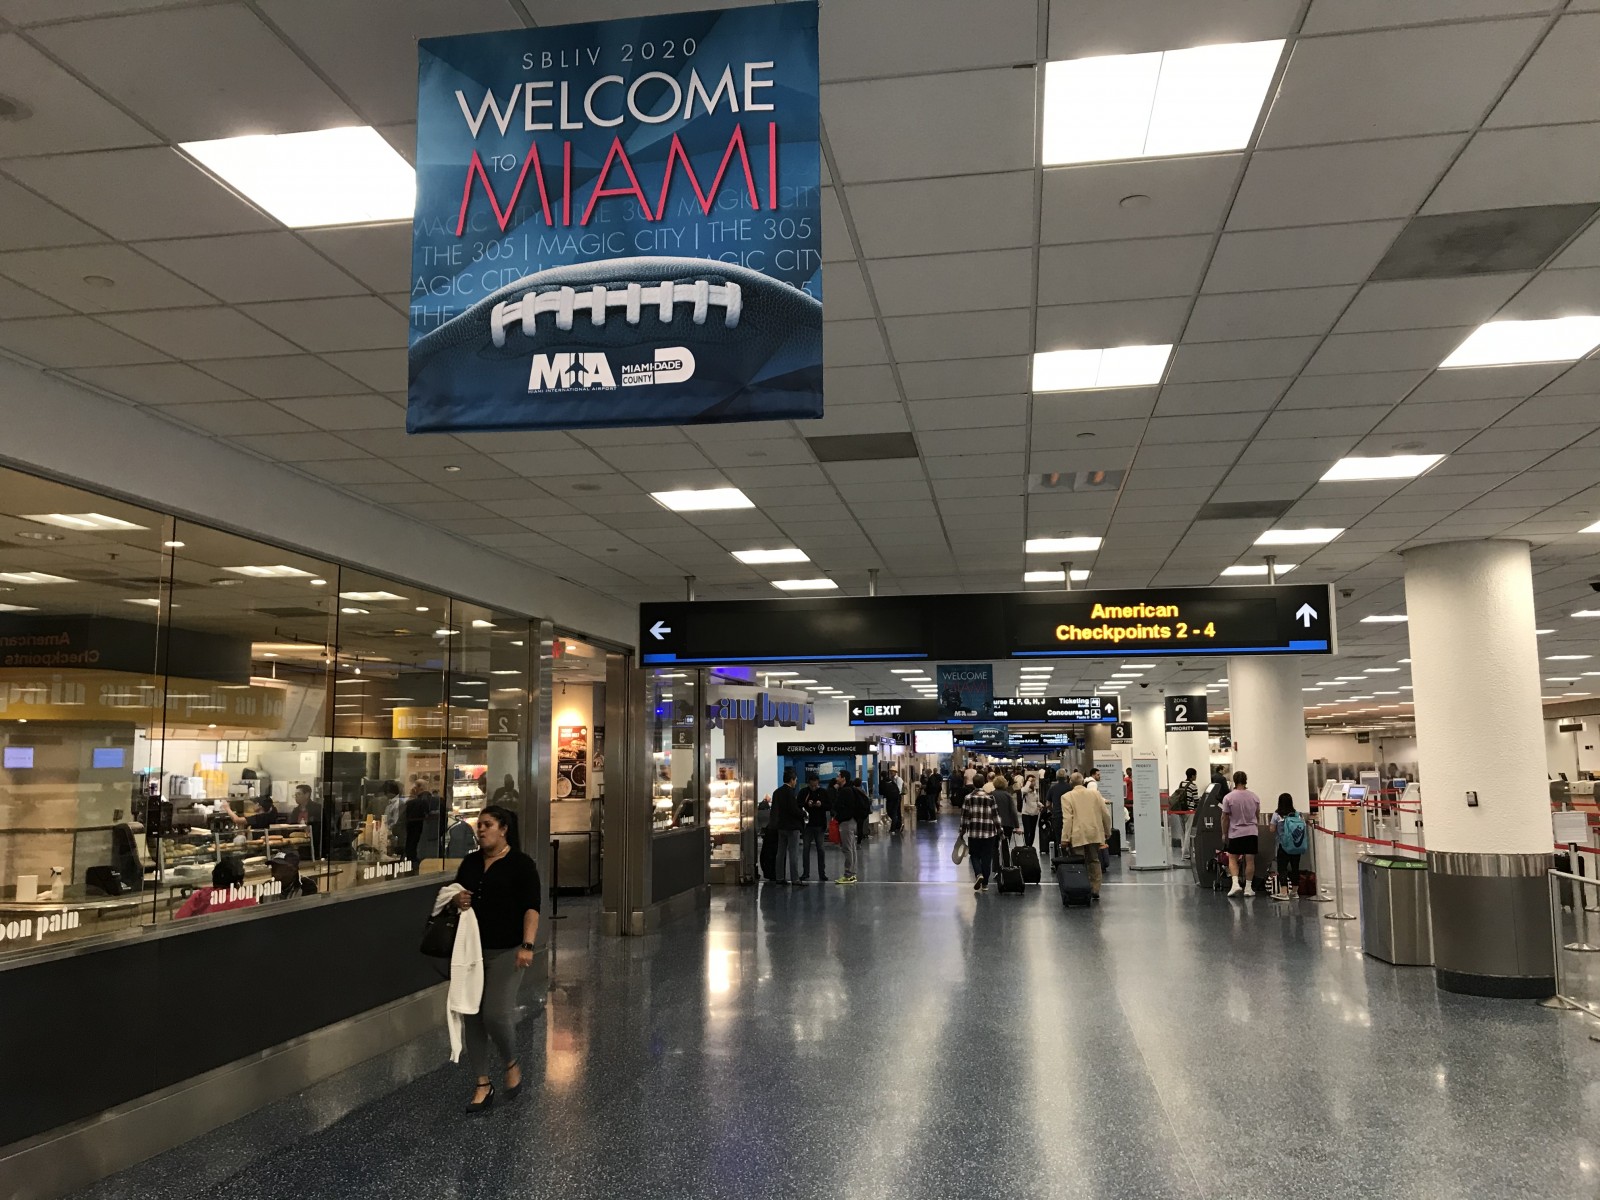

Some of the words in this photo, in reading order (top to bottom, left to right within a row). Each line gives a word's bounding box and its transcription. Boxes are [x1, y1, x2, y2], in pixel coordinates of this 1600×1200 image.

[522, 46, 601, 70] SBLIV
[621, 38, 696, 62] 2020
[455, 60, 774, 139] WELCOME
[491, 153, 517, 173] TO
[456, 122, 777, 237] MIAMI
[421, 244, 463, 266] THE
[472, 238, 514, 263] 305
[537, 231, 625, 255] MAGIC
[634, 227, 686, 250] CITY
[708, 219, 752, 243] THE
[763, 218, 811, 240] 305
[622, 372, 652, 385] COUNTY
[1090, 602, 1179, 619] American
[1055, 623, 1171, 643] Checkpoints
[1176, 622, 1188, 638] 2
[1203, 621, 1216, 638] 4
[943, 671, 988, 681] WELCOME
[263, 693, 284, 717] bo
[720, 699, 756, 721] au
[875, 705, 901, 717] EXIT
[1059, 698, 1090, 706] Ticketing
[1175, 704, 1188, 722] 2
[1116, 726, 1125, 738] 3
[364, 866, 375, 880] au
[376, 861, 393, 878] bon
[393, 857, 412, 878] pain
[210, 887, 227, 905] au
[229, 882, 254, 903] bon
[255, 877, 282, 905] pain
[36, 906, 79, 942] pain
